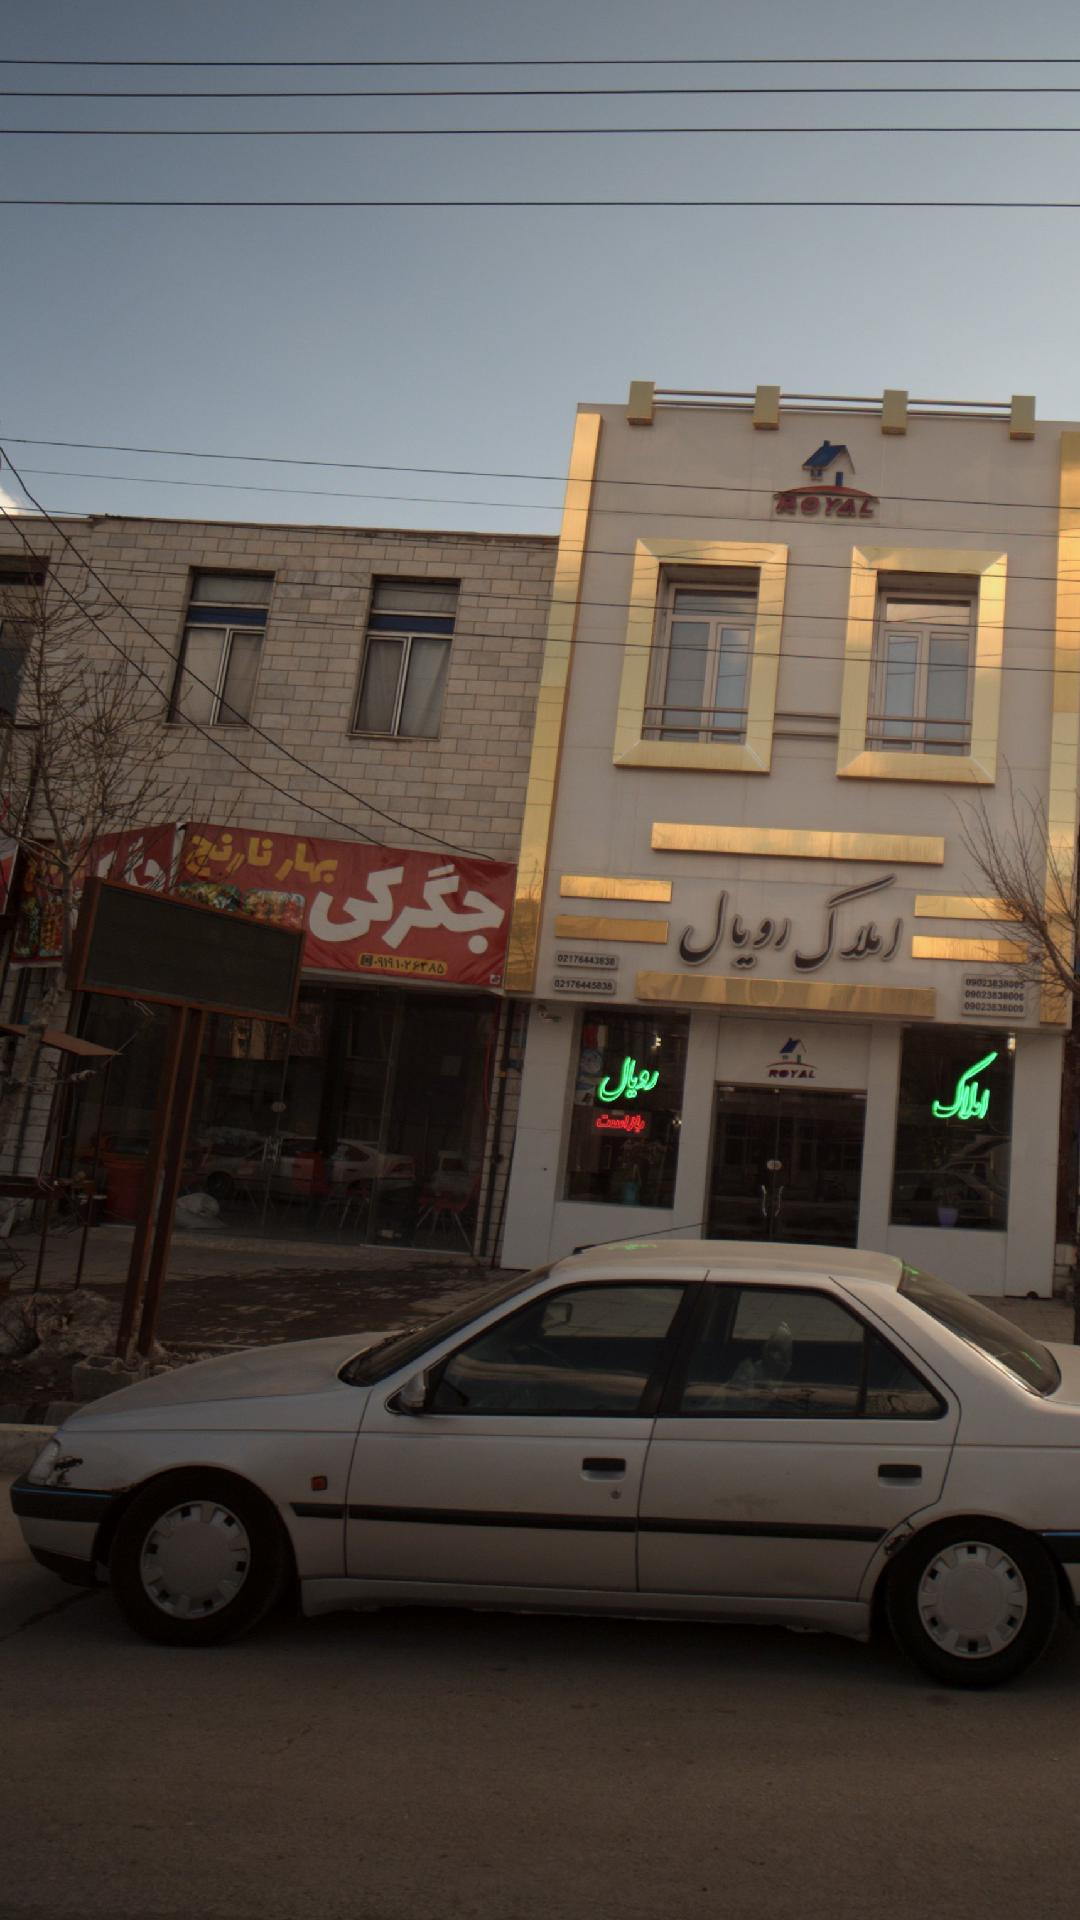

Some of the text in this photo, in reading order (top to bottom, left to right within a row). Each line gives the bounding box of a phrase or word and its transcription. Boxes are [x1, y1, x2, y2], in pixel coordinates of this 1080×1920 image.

[775, 495, 875, 518] ROYAL
[186, 833, 338, 884] بهار نارنج
[308, 863, 505, 955] جگرکی
[679, 873, 903, 973] املاک رویال
[598, 1055, 660, 1102] رویال
[767, 1069, 817, 1078] ROYAL
[931, 1051, 998, 1120] املاک
